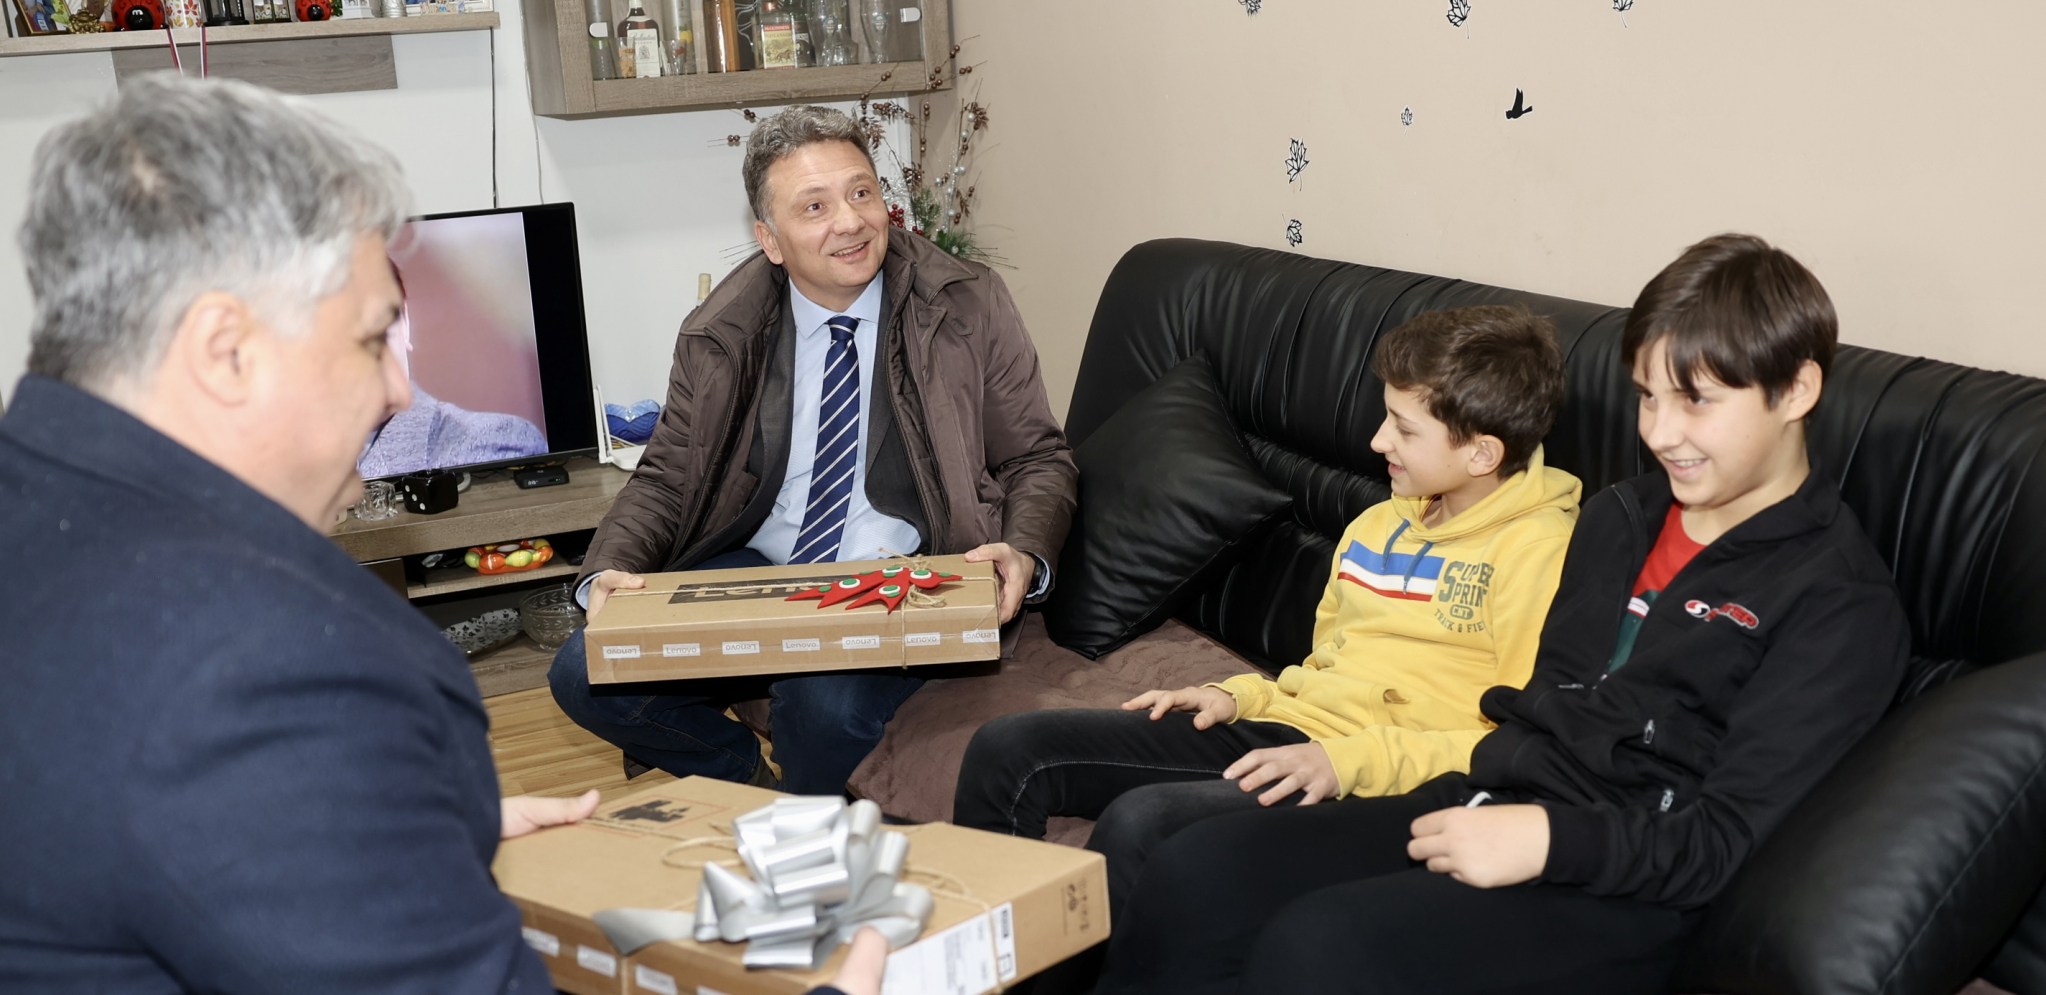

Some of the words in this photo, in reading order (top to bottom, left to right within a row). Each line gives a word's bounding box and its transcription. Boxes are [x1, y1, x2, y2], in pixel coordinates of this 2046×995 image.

[1439, 561, 1495, 596] SUPER
[1452, 605, 1470, 618] CNT
[1434, 608, 1455, 631] TRACK
[1466, 621, 1485, 633] FIE
[845, 638, 877, 646] Lenovo
[906, 636, 937, 644] Lenovo
[725, 643, 756, 651] Lenovo
[785, 641, 817, 649] Lenovo
[666, 646, 697, 654] Lenovo
